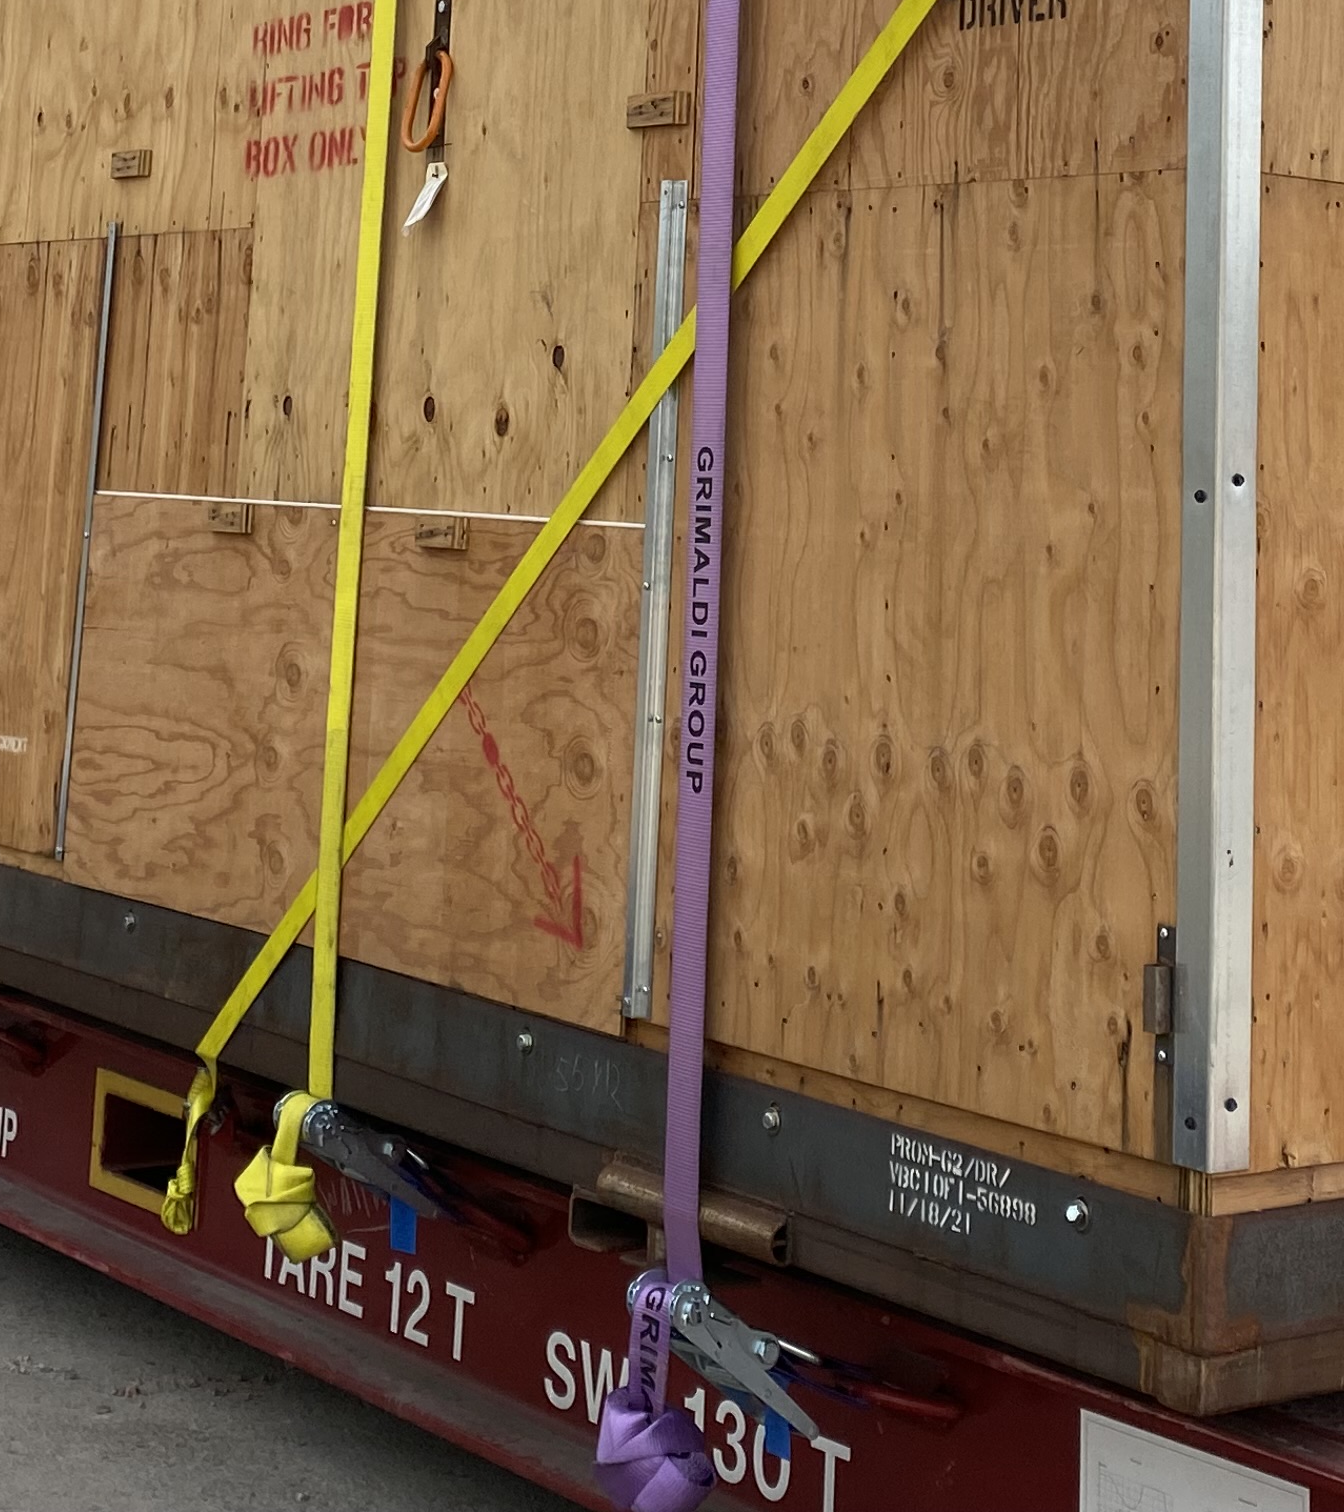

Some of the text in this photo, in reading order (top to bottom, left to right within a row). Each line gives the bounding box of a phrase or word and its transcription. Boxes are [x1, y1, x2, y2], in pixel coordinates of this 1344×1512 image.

[253, 0, 373, 56] RING FOR
[249, 55, 407, 117] LIFTING TP
[244, 133, 298, 179] BOX
[685, 447, 714, 795] GRIMALDI GROUP
[889, 1189, 971, 1236] 11/18/21
[385, 1261, 431, 1348] 12
[446, 1281, 476, 1362] T
[810, 1435, 851, 1512] T
